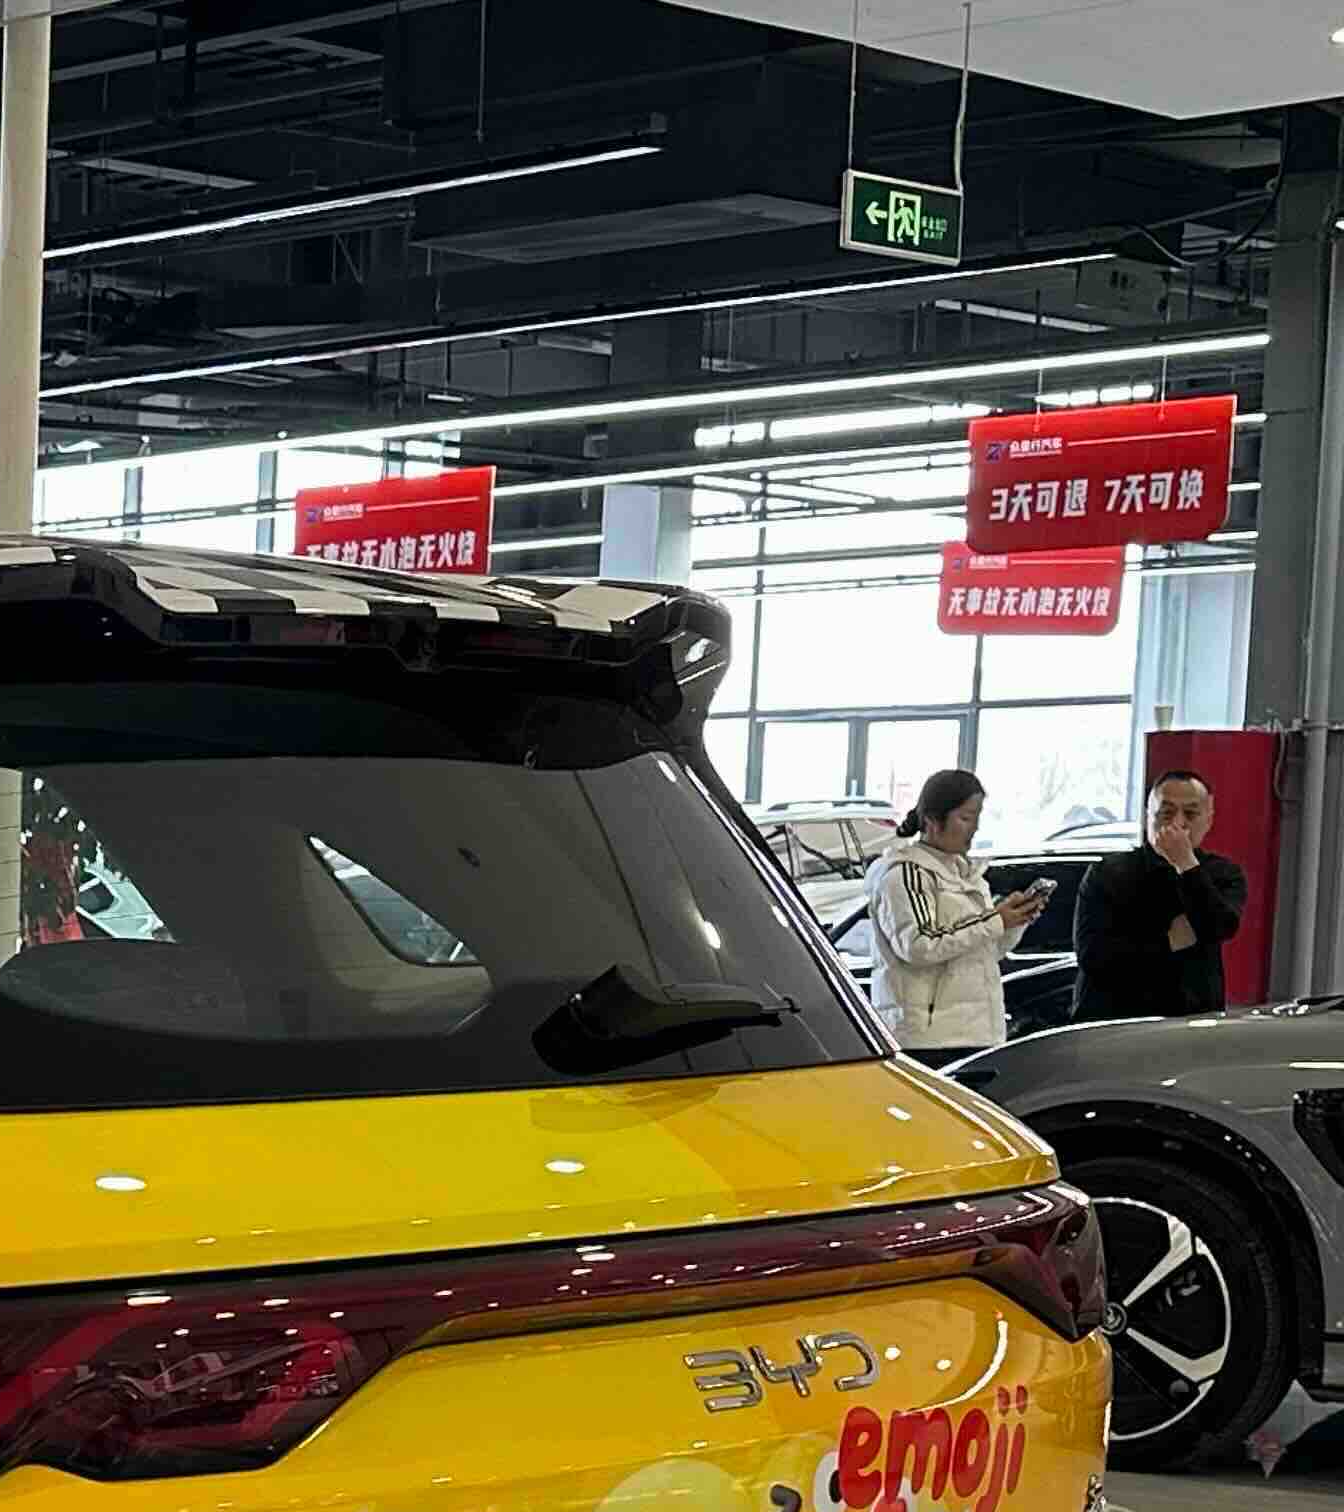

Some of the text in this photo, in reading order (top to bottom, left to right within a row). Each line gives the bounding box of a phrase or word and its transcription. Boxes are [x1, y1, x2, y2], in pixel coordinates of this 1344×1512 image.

[989, 469, 1205, 523] 3天可退 7天可换
